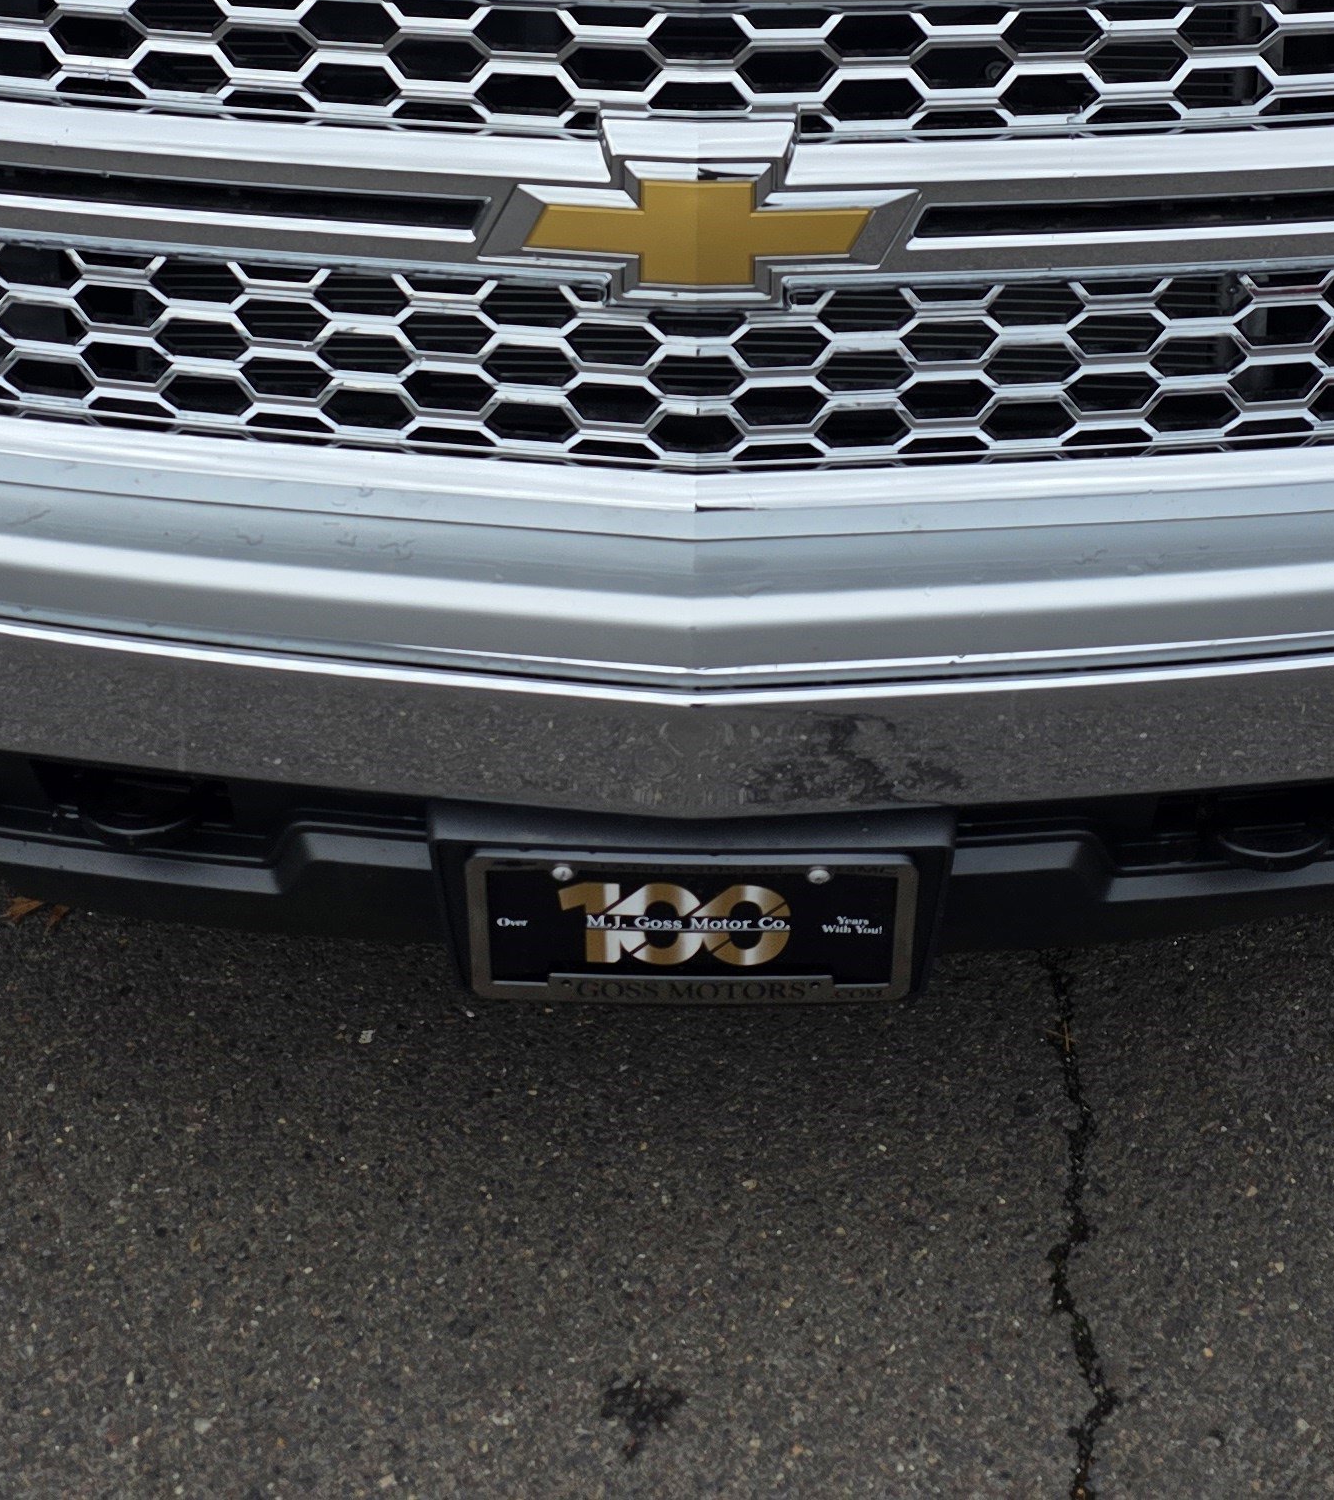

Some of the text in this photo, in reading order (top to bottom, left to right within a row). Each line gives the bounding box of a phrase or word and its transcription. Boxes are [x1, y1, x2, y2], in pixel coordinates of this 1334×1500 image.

[496, 917, 529, 927] Over
[558, 882, 791, 966] 100
[586, 914, 791, 930] M.J. Goss Motor Co.
[821, 924, 883, 935] With You!
[576, 980, 658, 999] GOSS
[666, 980, 807, 999] MOTORS
